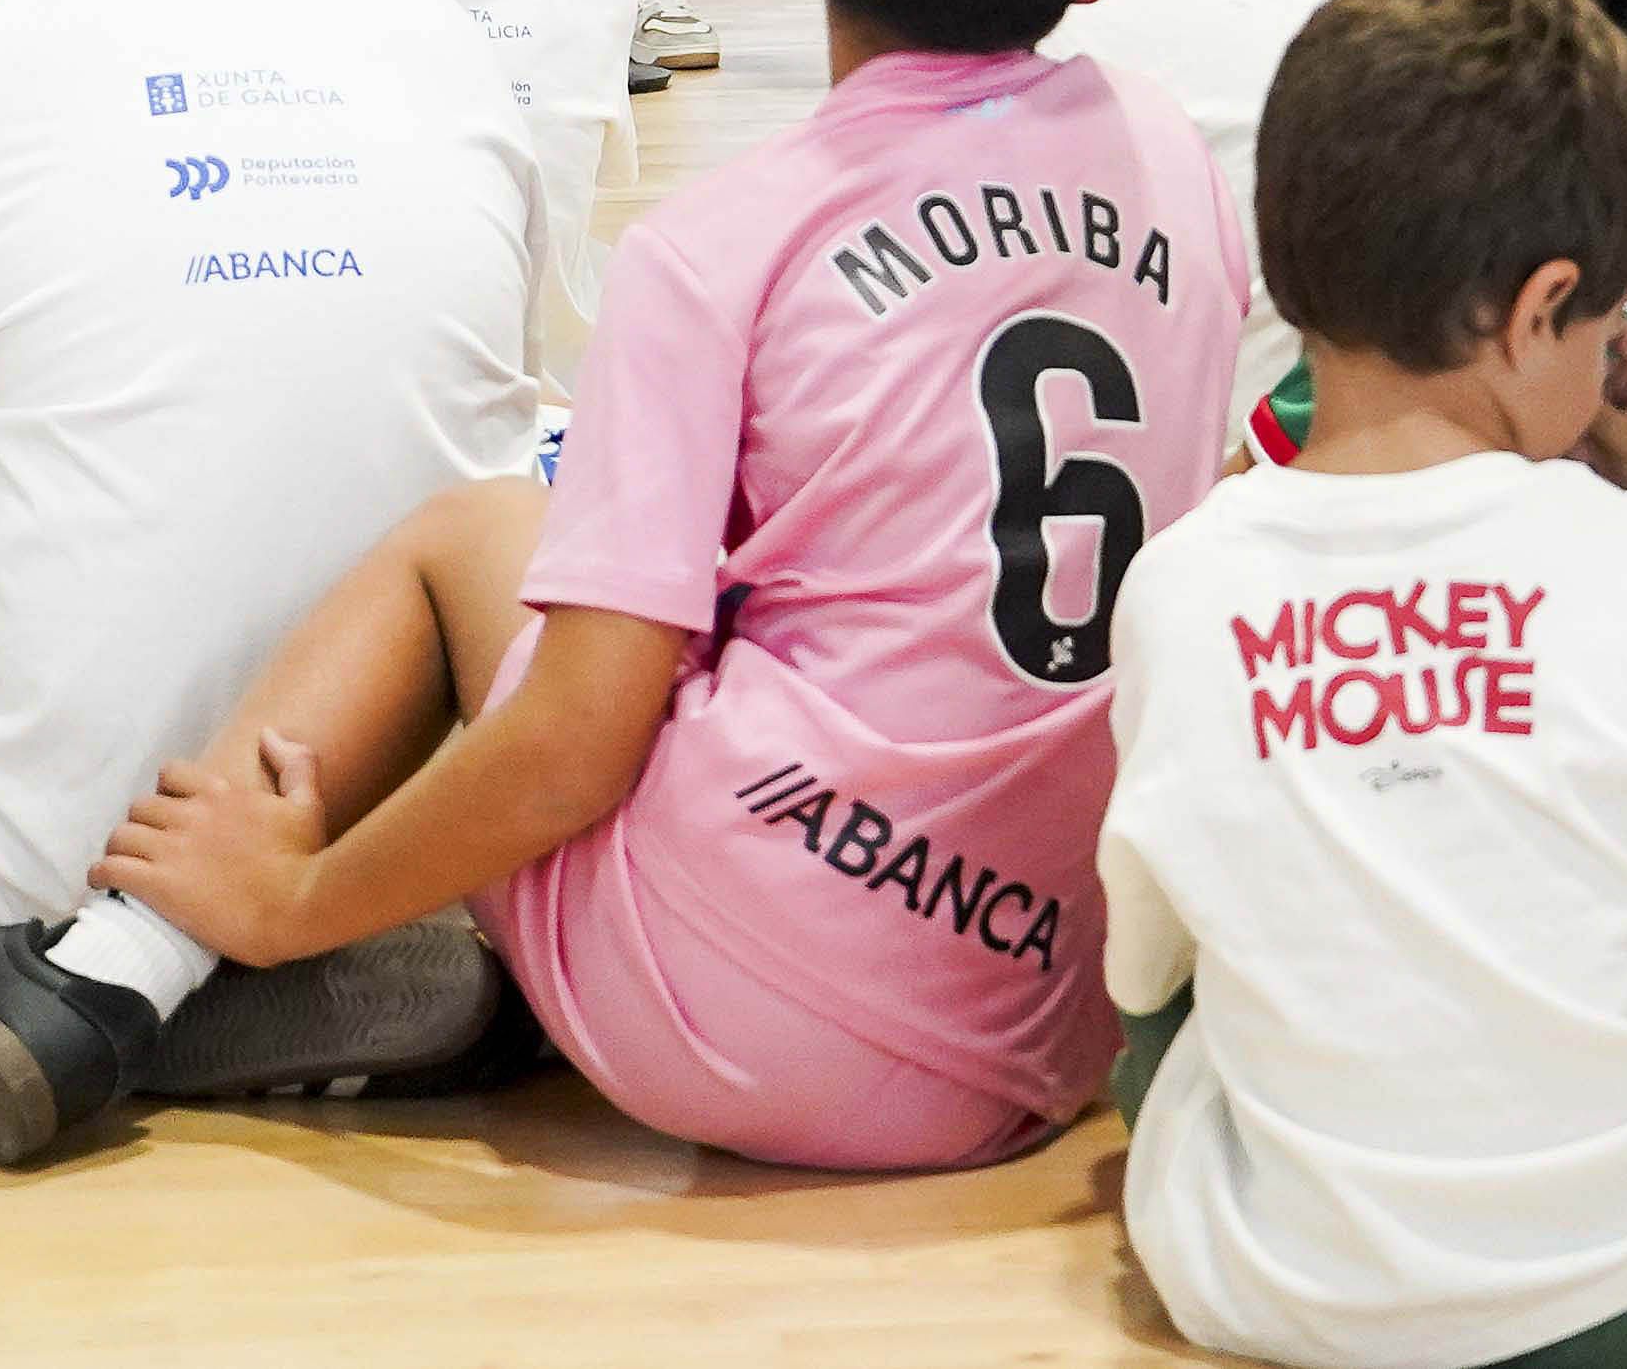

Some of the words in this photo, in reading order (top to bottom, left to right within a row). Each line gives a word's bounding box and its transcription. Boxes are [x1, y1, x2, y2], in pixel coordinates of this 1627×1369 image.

[195, 70, 286, 88] XUNTA
[198, 90, 230, 108] DE
[241, 88, 345, 106] GALICIA
[240, 157, 356, 172] Deputación
[243, 171, 359, 187] Pontevedra
[832, 182, 1173, 317] MORIBA
[973, 309, 1146, 691] 6
[1230, 580, 1546, 680] MICKEY
[1252, 654, 1534, 759] MOUSE
